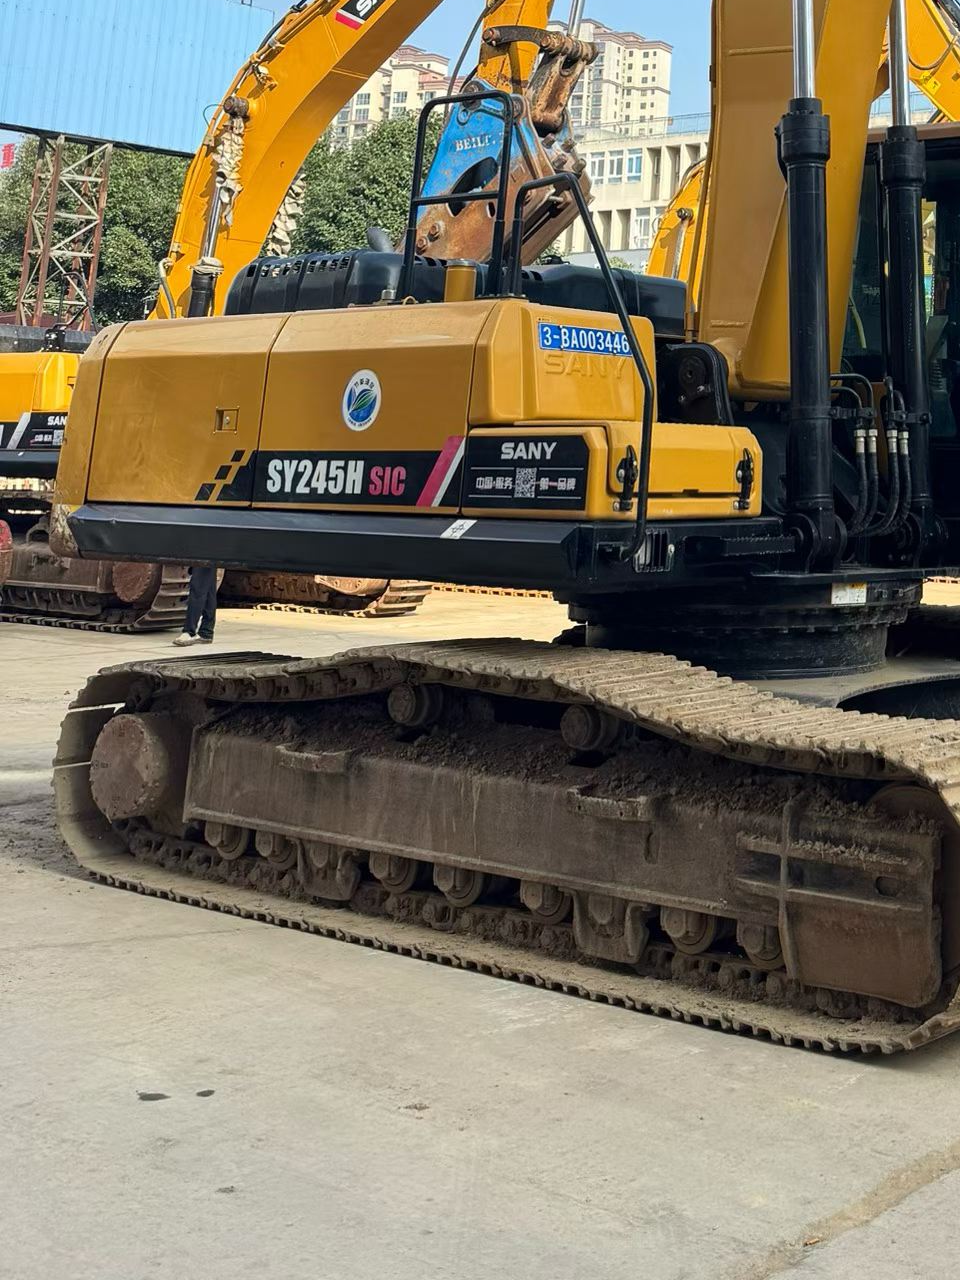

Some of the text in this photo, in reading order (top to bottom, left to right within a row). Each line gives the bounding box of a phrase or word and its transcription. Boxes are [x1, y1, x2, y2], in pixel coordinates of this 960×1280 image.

[543, 326, 630, 353] 3-BA003446
[544, 353, 627, 379] SANY
[501, 442, 557, 460] SANY
[266, 459, 407, 496] SY245H SIC
[539, 477, 576, 491] 第一品牌
